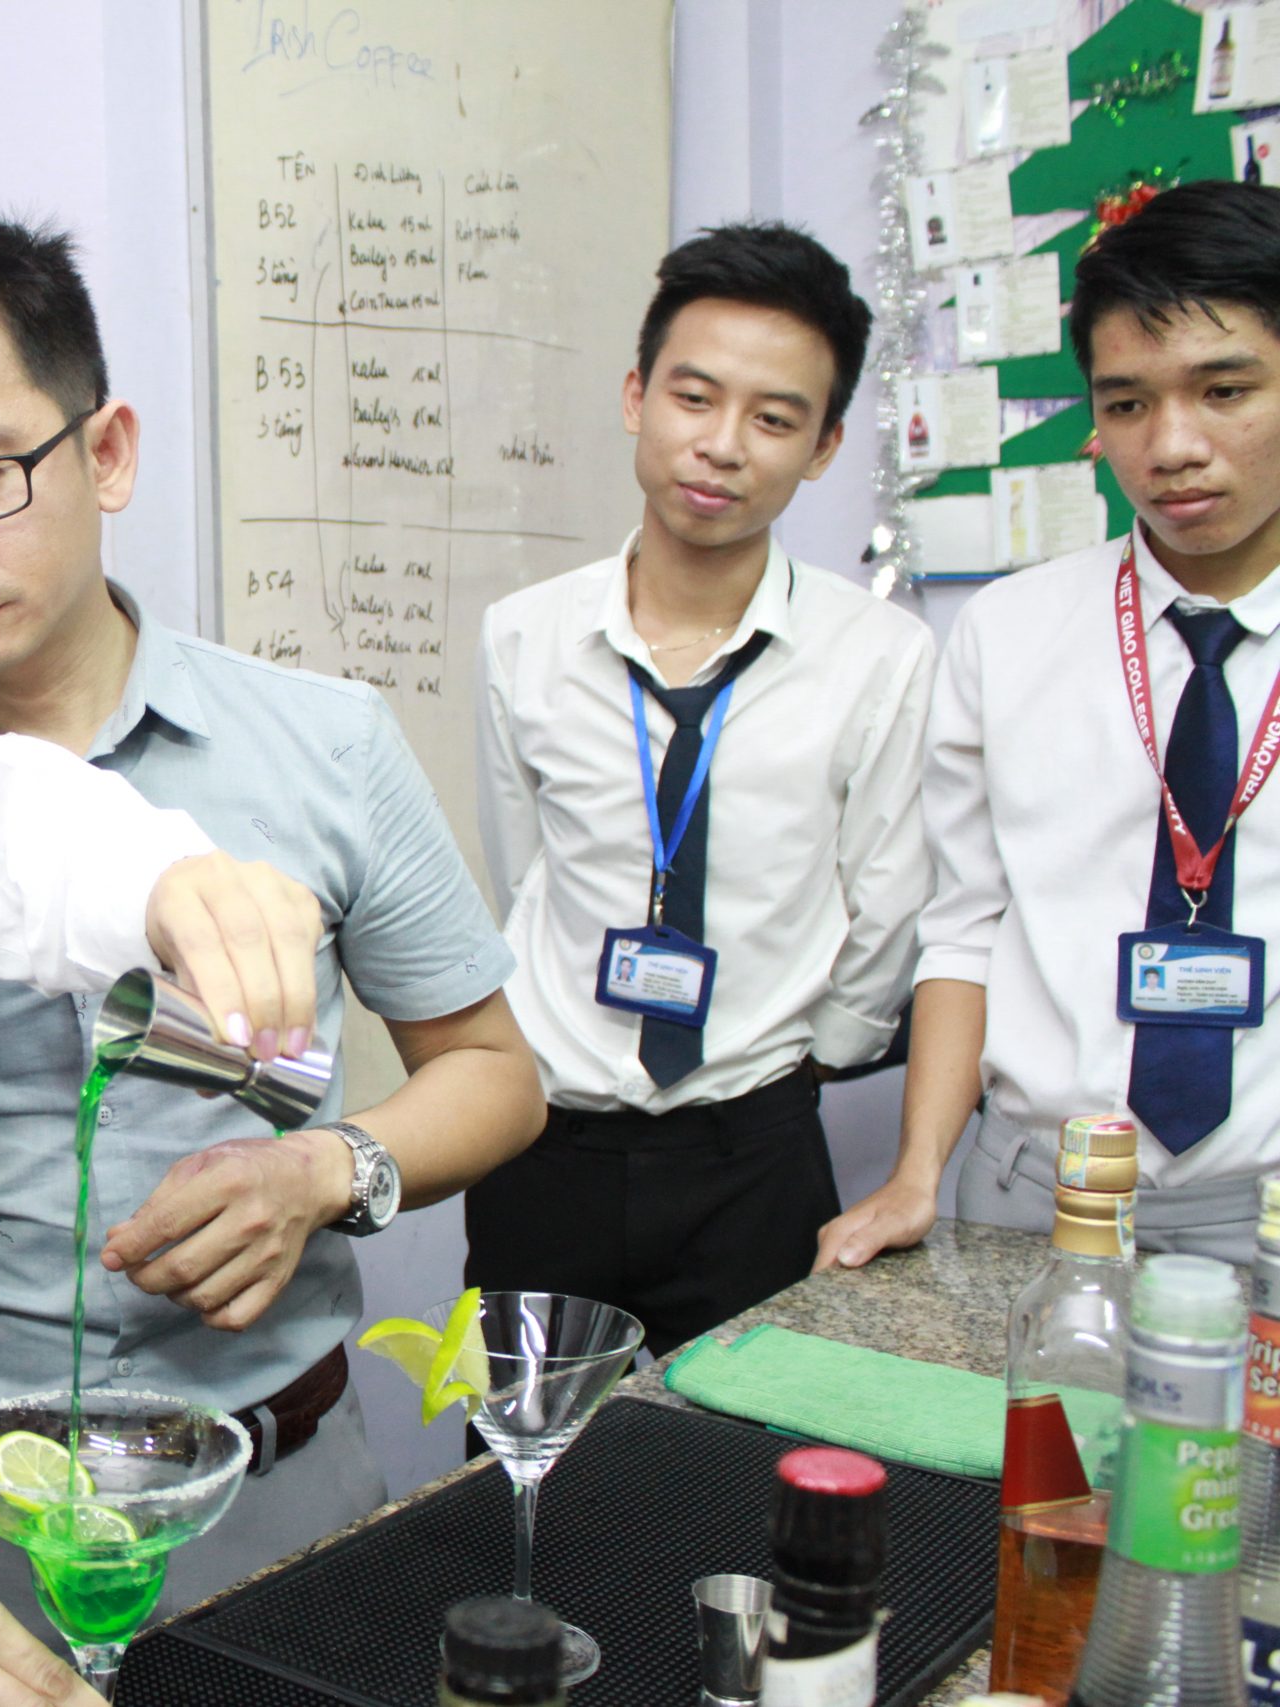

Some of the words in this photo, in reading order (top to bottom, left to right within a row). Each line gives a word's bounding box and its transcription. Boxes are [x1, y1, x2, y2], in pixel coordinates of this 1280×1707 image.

[1119, 570, 1133, 608] VIET
[1121, 611, 1137, 655] GIAO
[1126, 657, 1150, 740] COLLEGE
[1239, 720, 1280, 804] TRƯỜNG
[1250, 1366, 1280, 1396] Se
